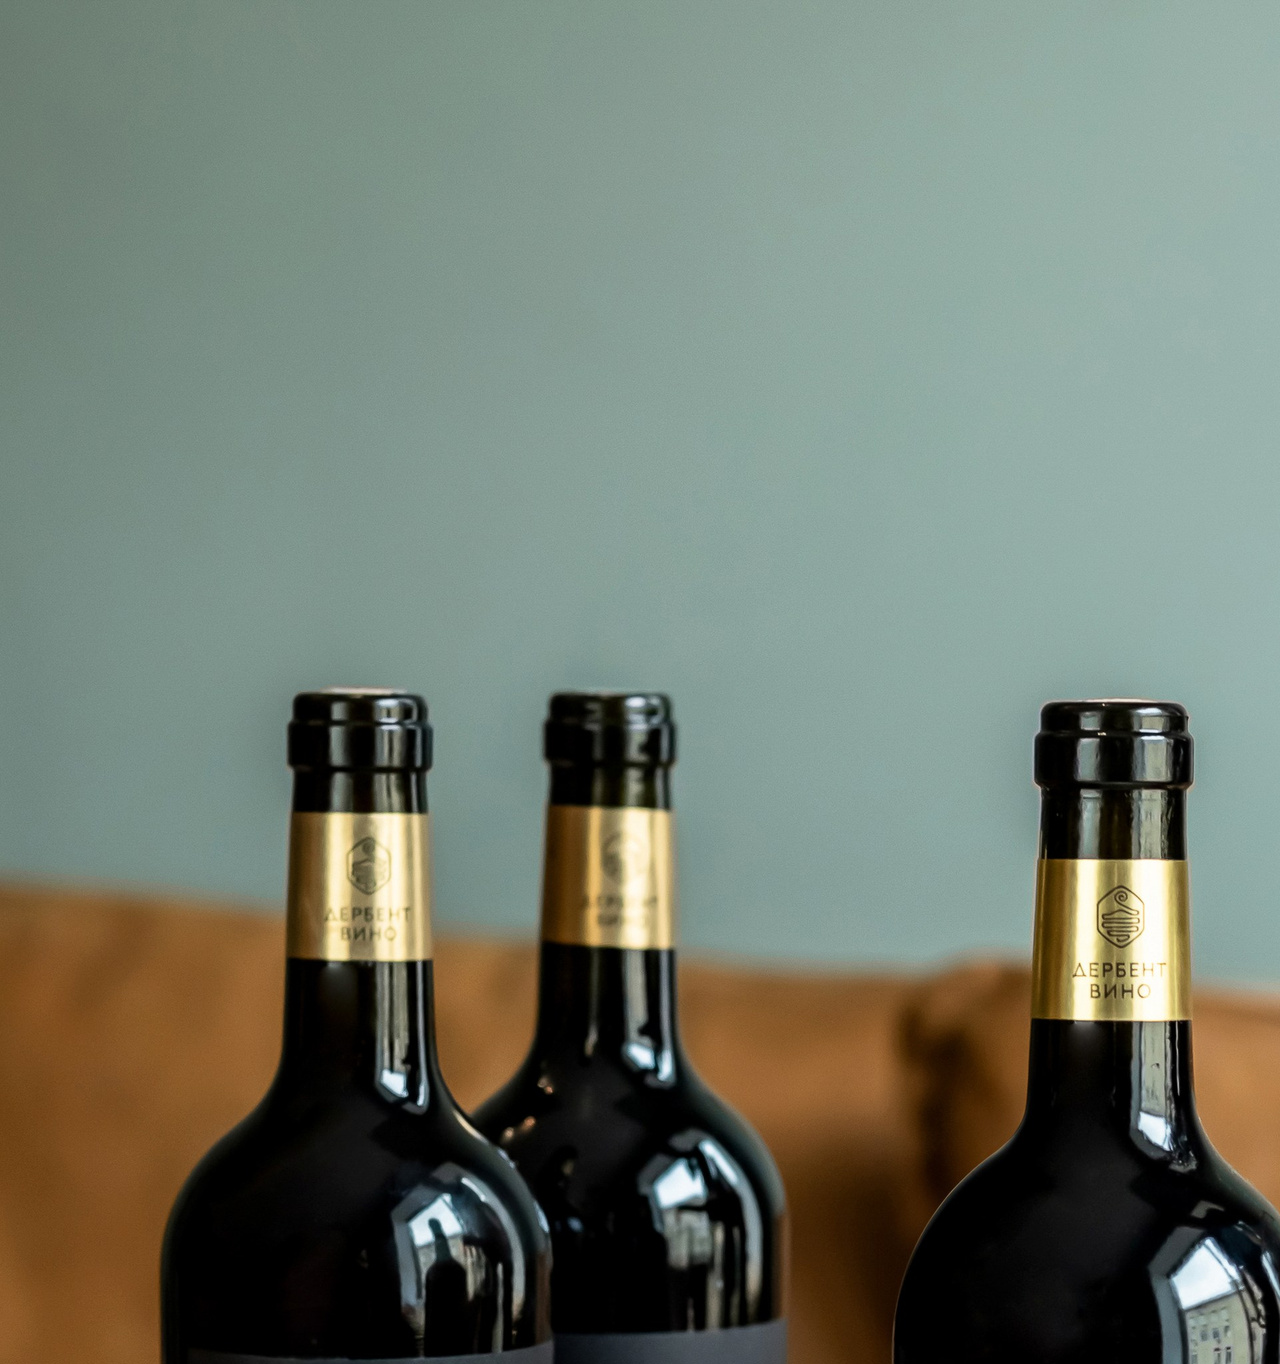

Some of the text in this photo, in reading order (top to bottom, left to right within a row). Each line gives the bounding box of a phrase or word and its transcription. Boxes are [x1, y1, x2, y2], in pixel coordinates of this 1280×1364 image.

[324, 906, 412, 922] ДЕРБЕНТ
[340, 926, 397, 942] ВИНО
[1072, 962, 1167, 978] ДЕРБЕНТ
[1090, 983, 1151, 999] ВИНО
